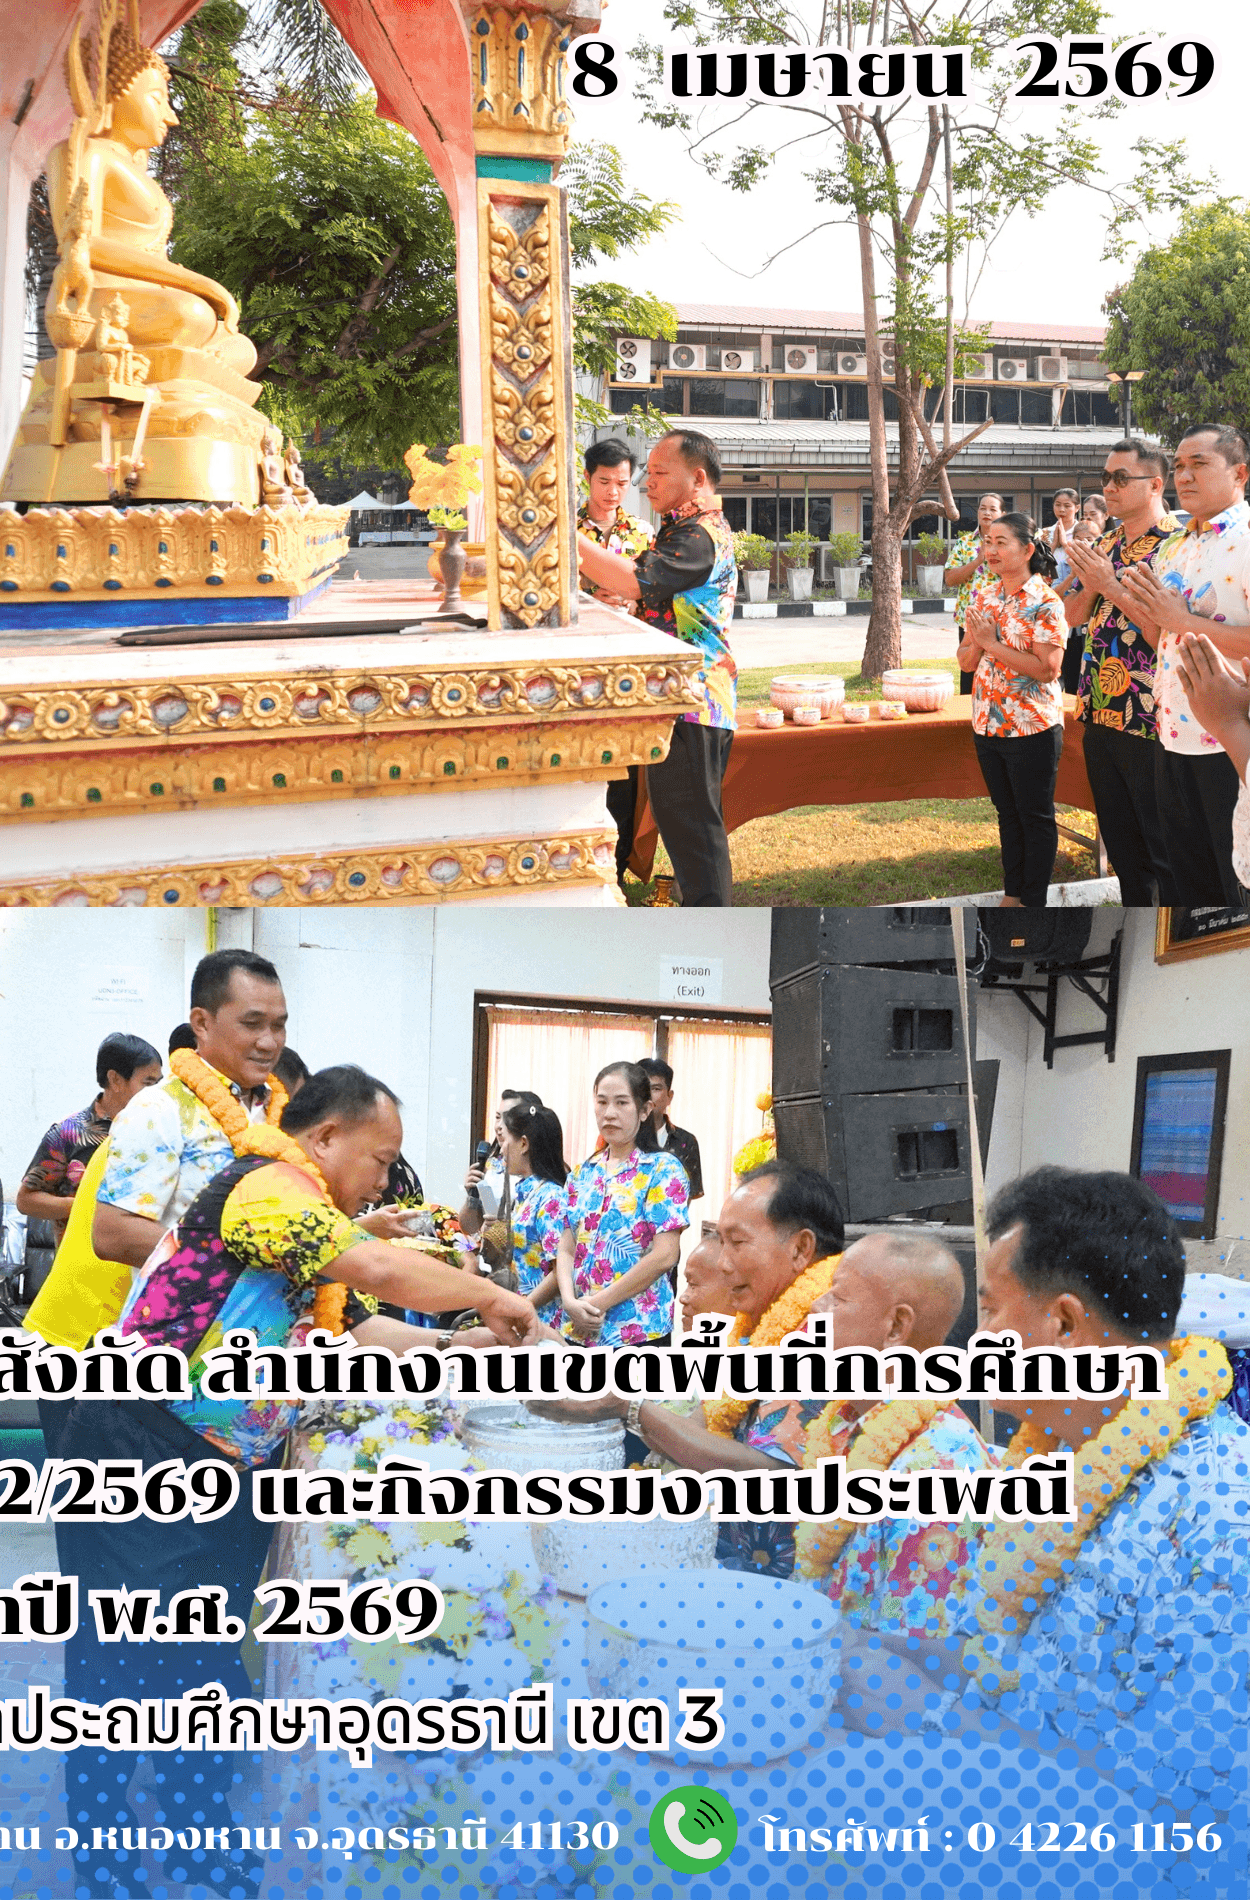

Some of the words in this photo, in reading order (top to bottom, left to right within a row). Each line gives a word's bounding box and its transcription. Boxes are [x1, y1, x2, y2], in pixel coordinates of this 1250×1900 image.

[671, 966, 711, 976] ทางออก
[677, 985, 705, 997] (Exit)
